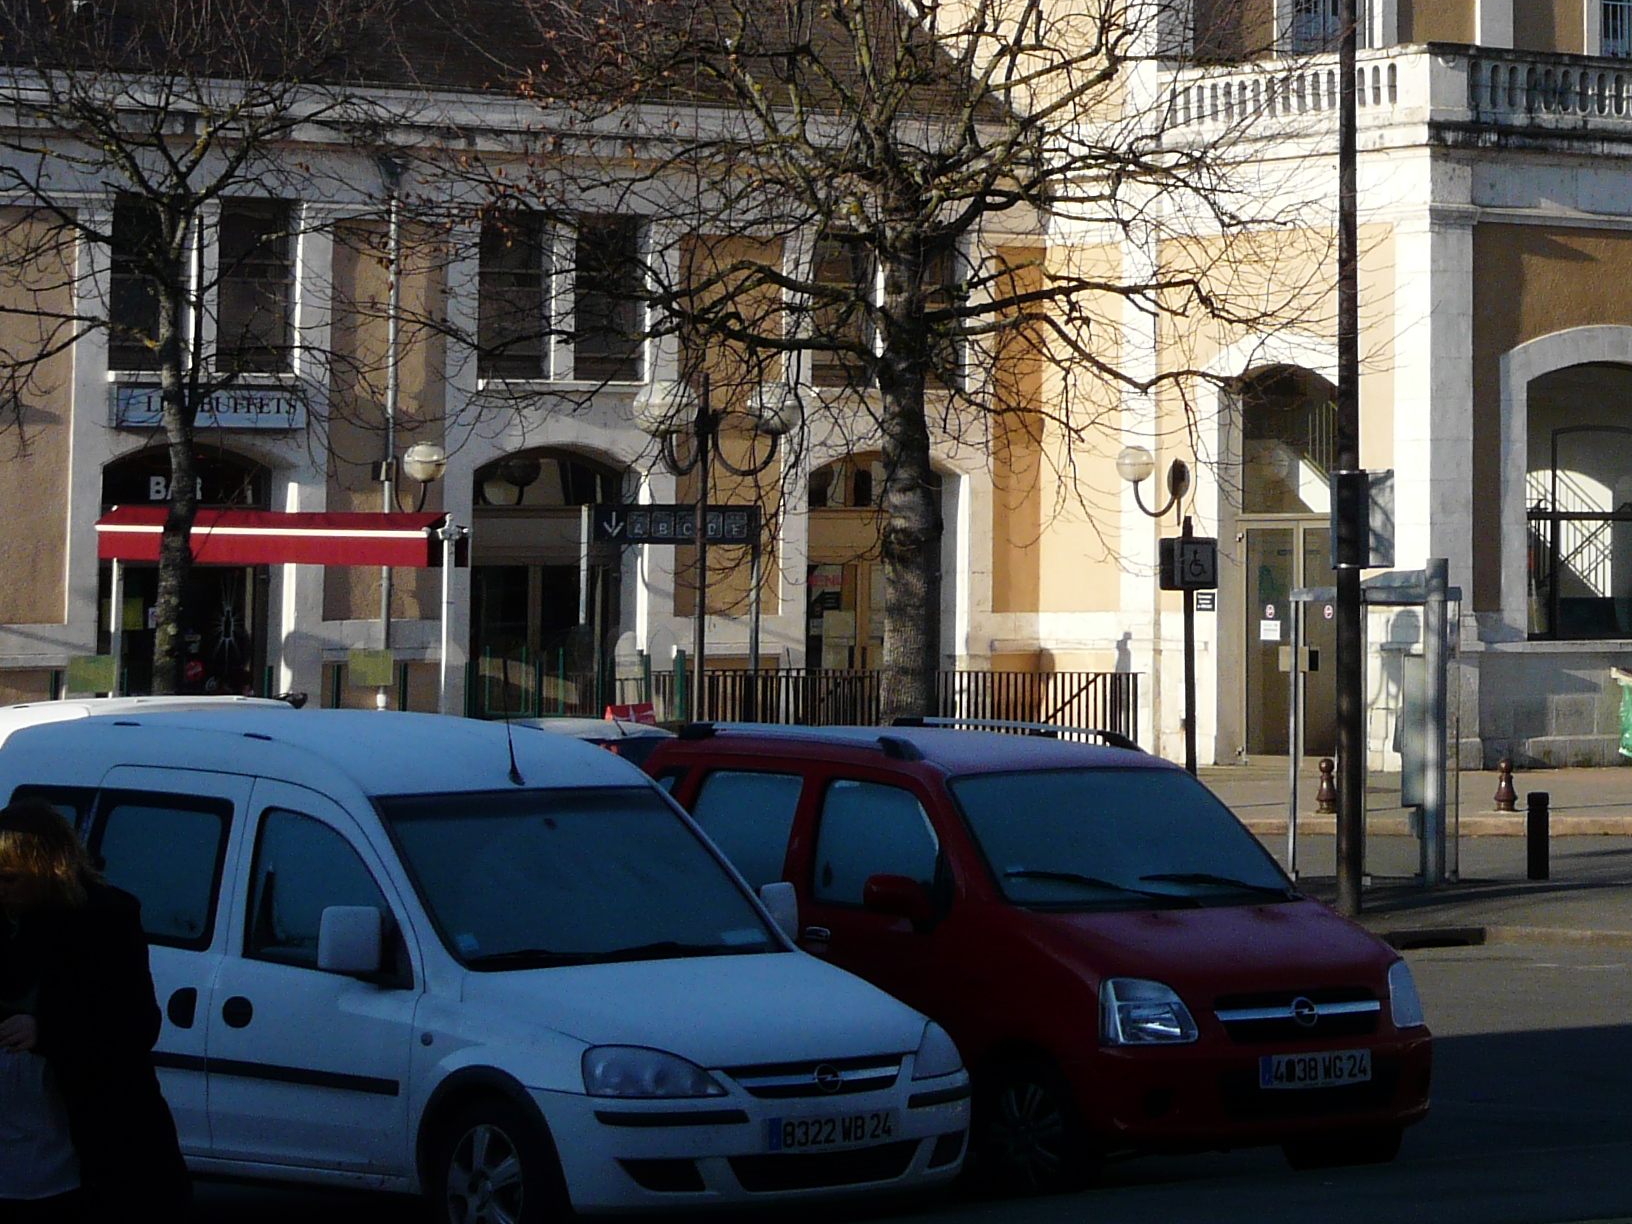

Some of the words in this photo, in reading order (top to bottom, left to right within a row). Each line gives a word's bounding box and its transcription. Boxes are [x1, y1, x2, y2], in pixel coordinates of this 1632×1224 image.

[1347, 1054, 1367, 1078] 24
[782, 1118, 836, 1148] 8322
[869, 1112, 892, 1139] 24
